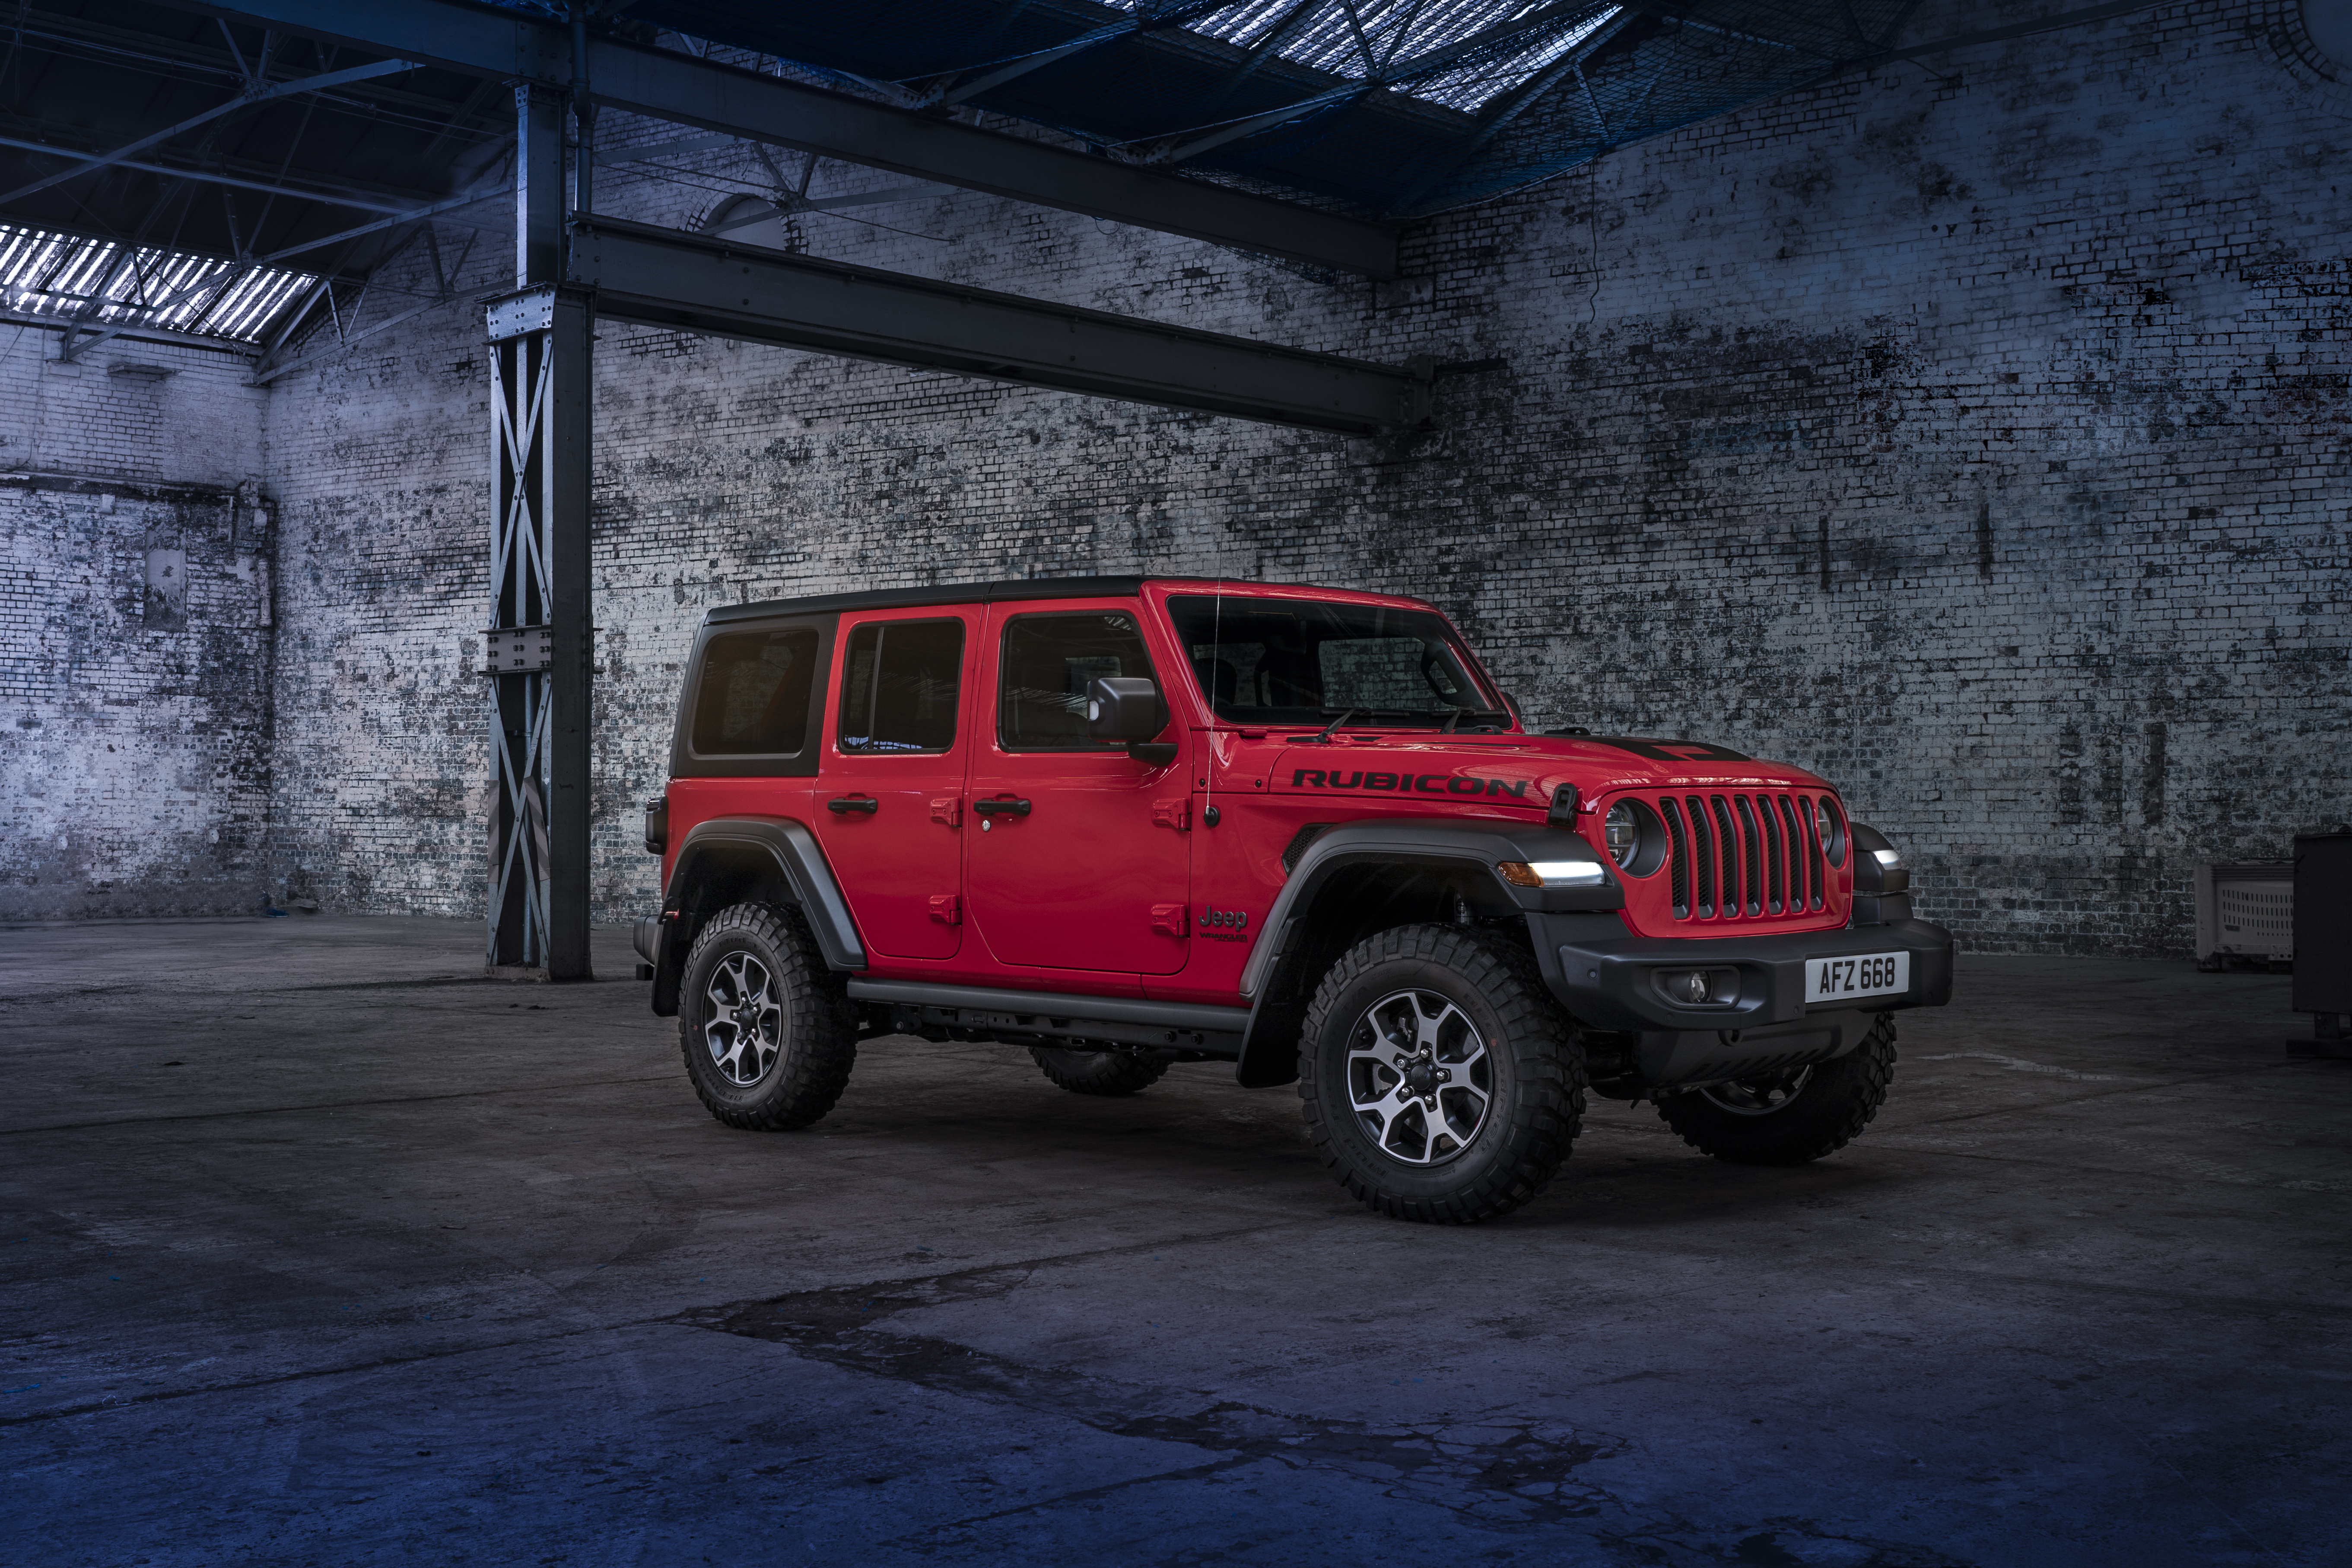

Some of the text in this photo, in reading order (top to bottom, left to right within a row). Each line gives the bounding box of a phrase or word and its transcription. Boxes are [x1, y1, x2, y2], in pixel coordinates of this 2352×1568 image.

[1292, 769, 1527, 798] RUBICON
[1198, 905, 1247, 932] Jeep
[1819, 957, 1895, 994] AFZ 668
[1412, 1071, 1428, 1082] Jeep
